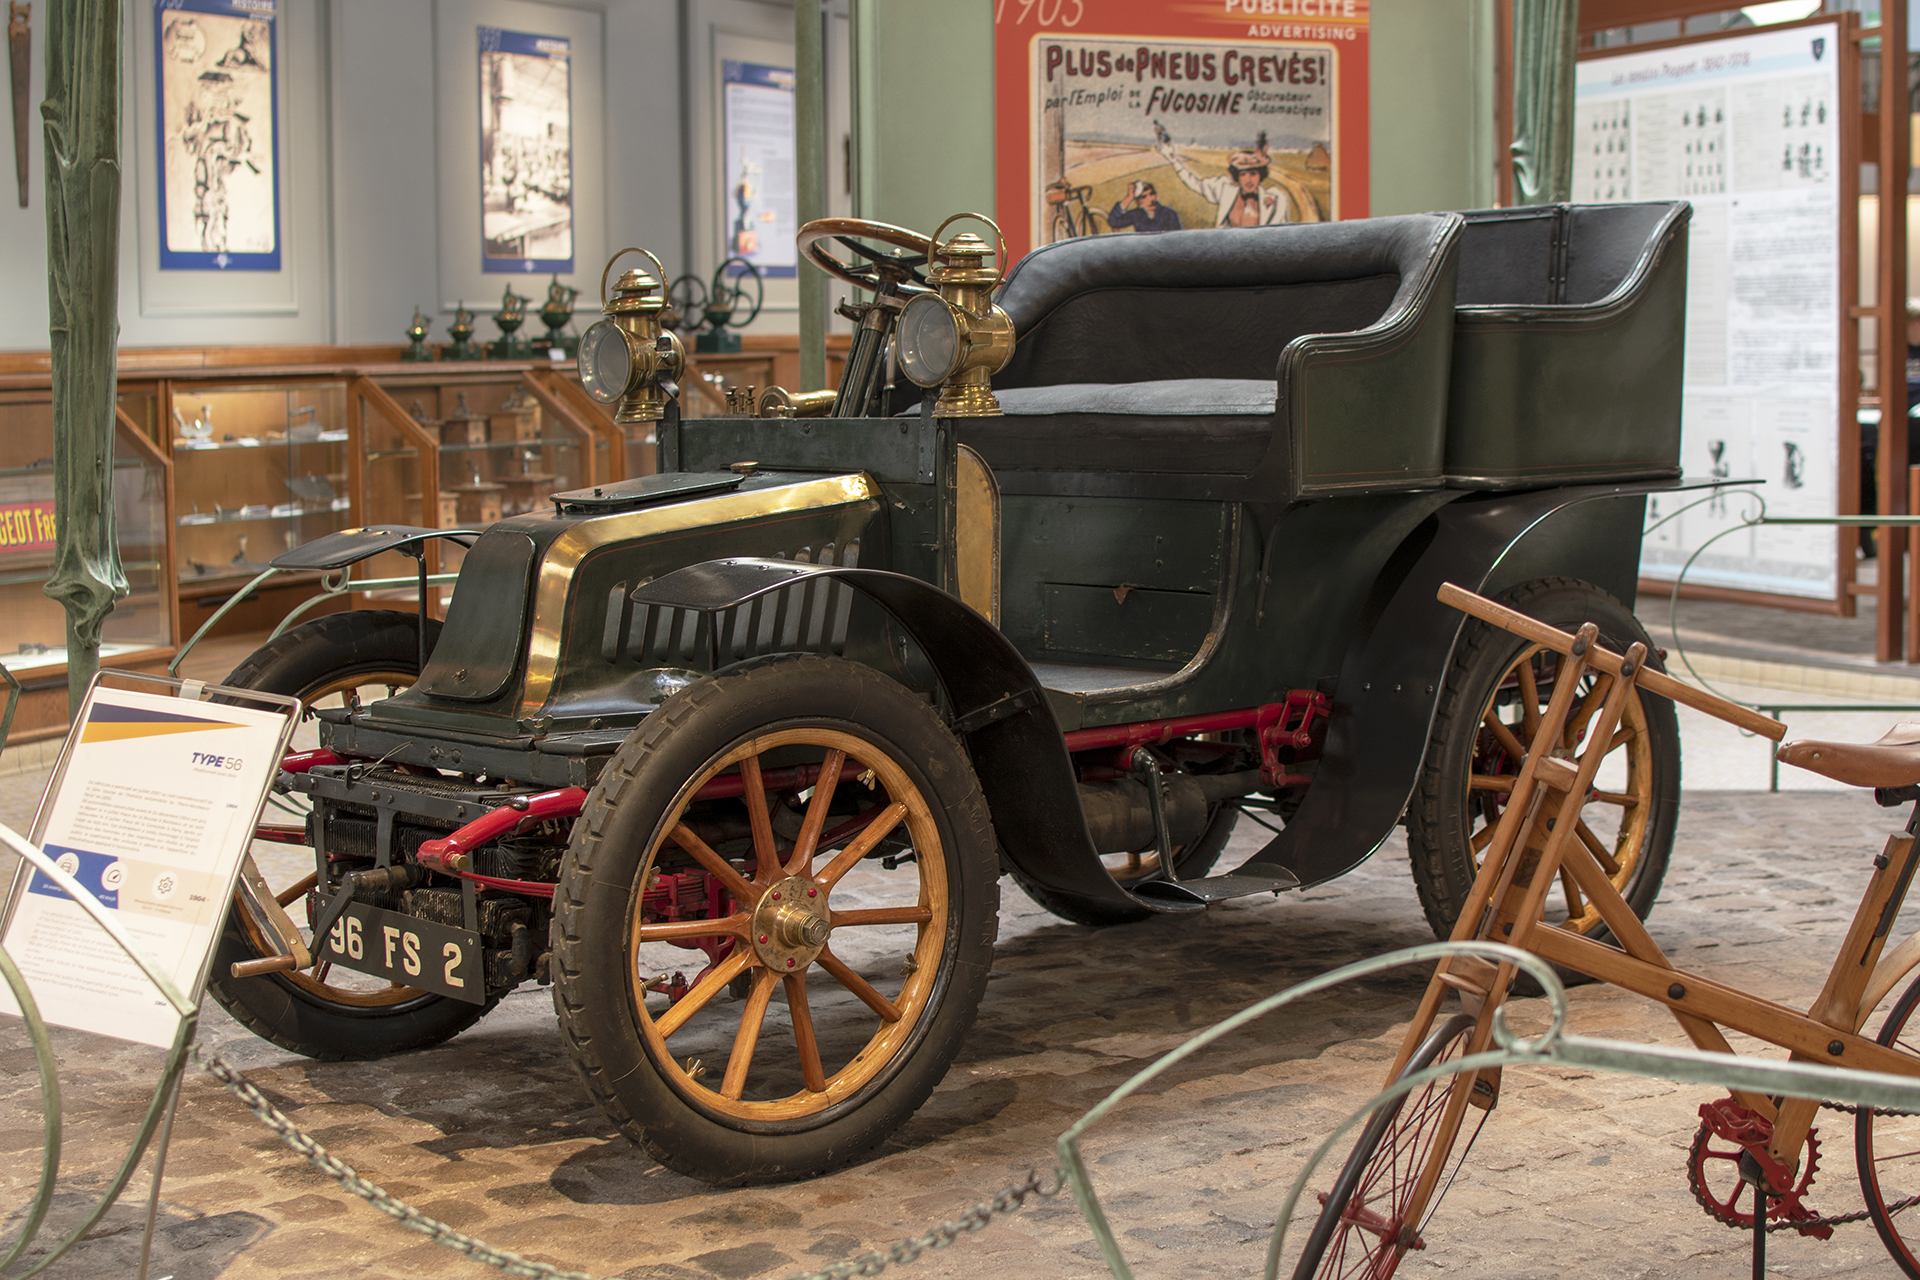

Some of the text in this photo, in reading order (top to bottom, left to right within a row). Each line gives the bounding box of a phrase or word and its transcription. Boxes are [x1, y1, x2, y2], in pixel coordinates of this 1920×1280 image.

[1247, 25, 1357, 41] ADVERTISING
[1047, 45, 1112, 82] PLUS
[1115, 54, 1134, 72] de
[1136, 47, 1216, 82] PNEUS
[1045, 96, 1067, 112] par
[1145, 86, 1244, 116] FUCOSINE
[192, 752, 243, 771] TYPE 56
[330, 916, 465, 988] 96 FS 2
